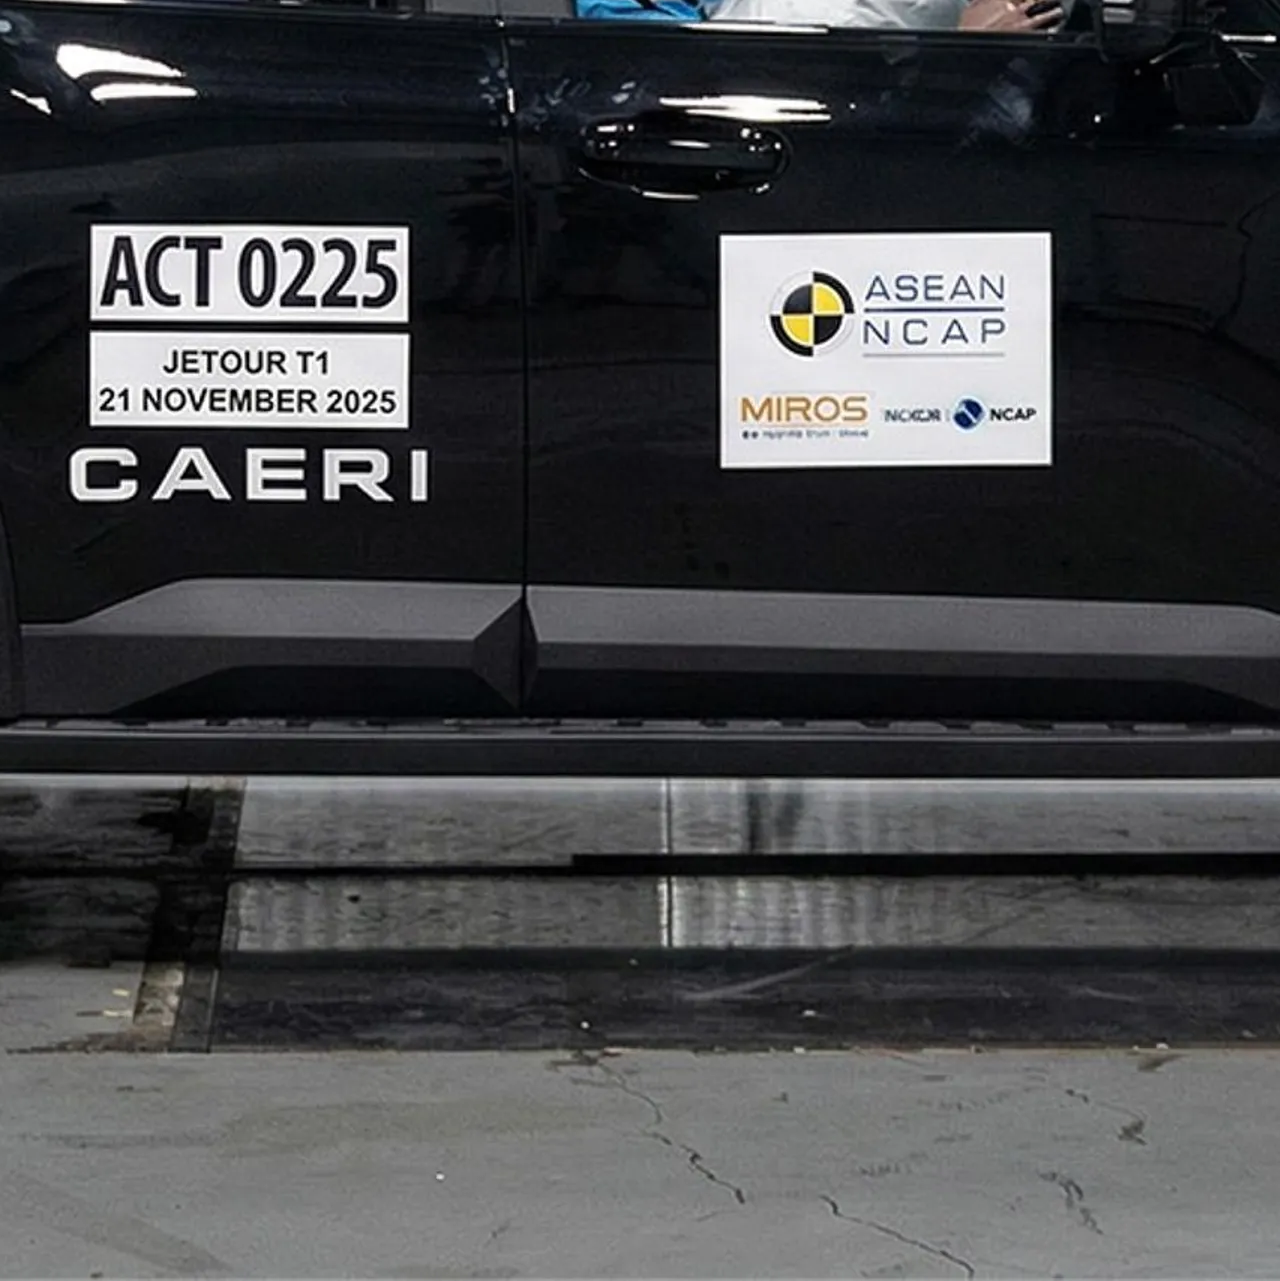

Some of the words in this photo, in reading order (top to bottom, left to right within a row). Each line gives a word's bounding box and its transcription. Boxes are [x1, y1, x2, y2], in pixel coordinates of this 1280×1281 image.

[99, 235, 222, 308] ACT
[238, 237, 398, 308] 0225
[864, 274, 1005, 302] ASEAN
[863, 318, 1006, 345] NCAP
[162, 349, 287, 375] JETOUR
[296, 350, 330, 375] T1
[98, 387, 130, 412] 21
[142, 388, 318, 413] NOVEMBER
[326, 389, 397, 414] 2025
[740, 395, 868, 423] MIROS
[989, 407, 1037, 422] NCAP
[68, 446, 429, 502] CAERI
